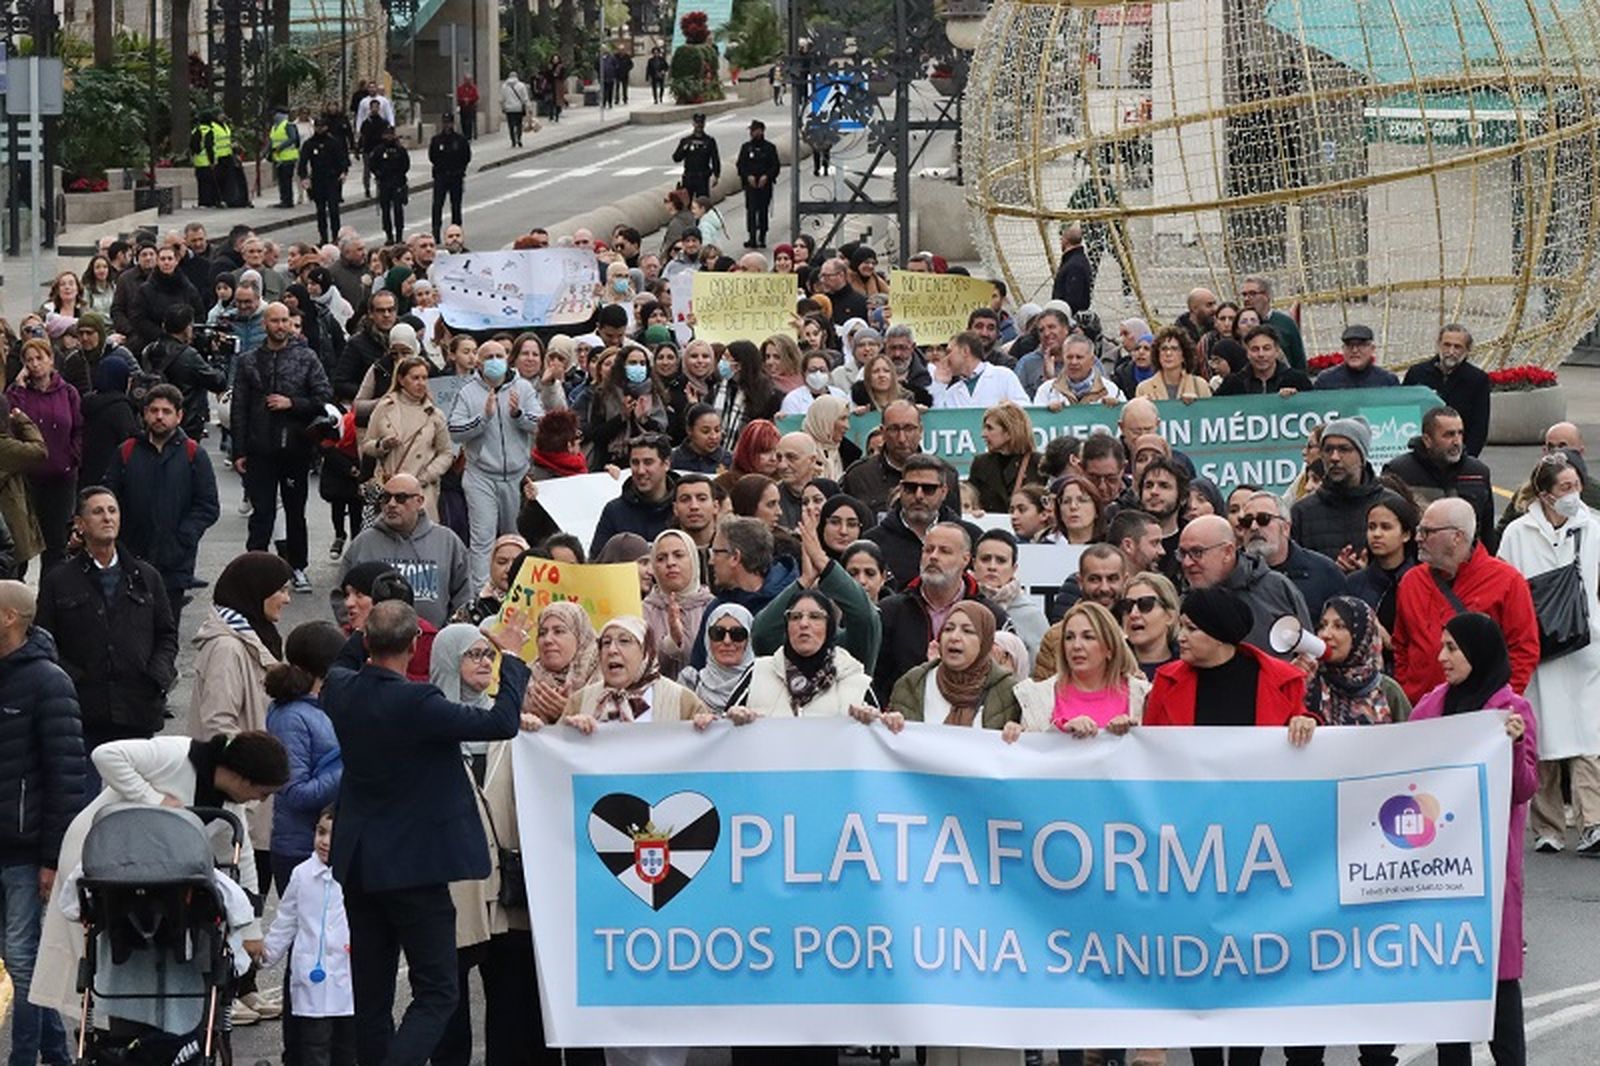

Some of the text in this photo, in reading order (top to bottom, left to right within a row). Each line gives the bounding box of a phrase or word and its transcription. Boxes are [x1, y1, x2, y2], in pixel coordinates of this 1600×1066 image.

[531, 563, 560, 585] NO
[730, 811, 1294, 894] PLATAFORMA
[593, 919, 1486, 978] TODOS POR UNA SANIDAD DIGNA
